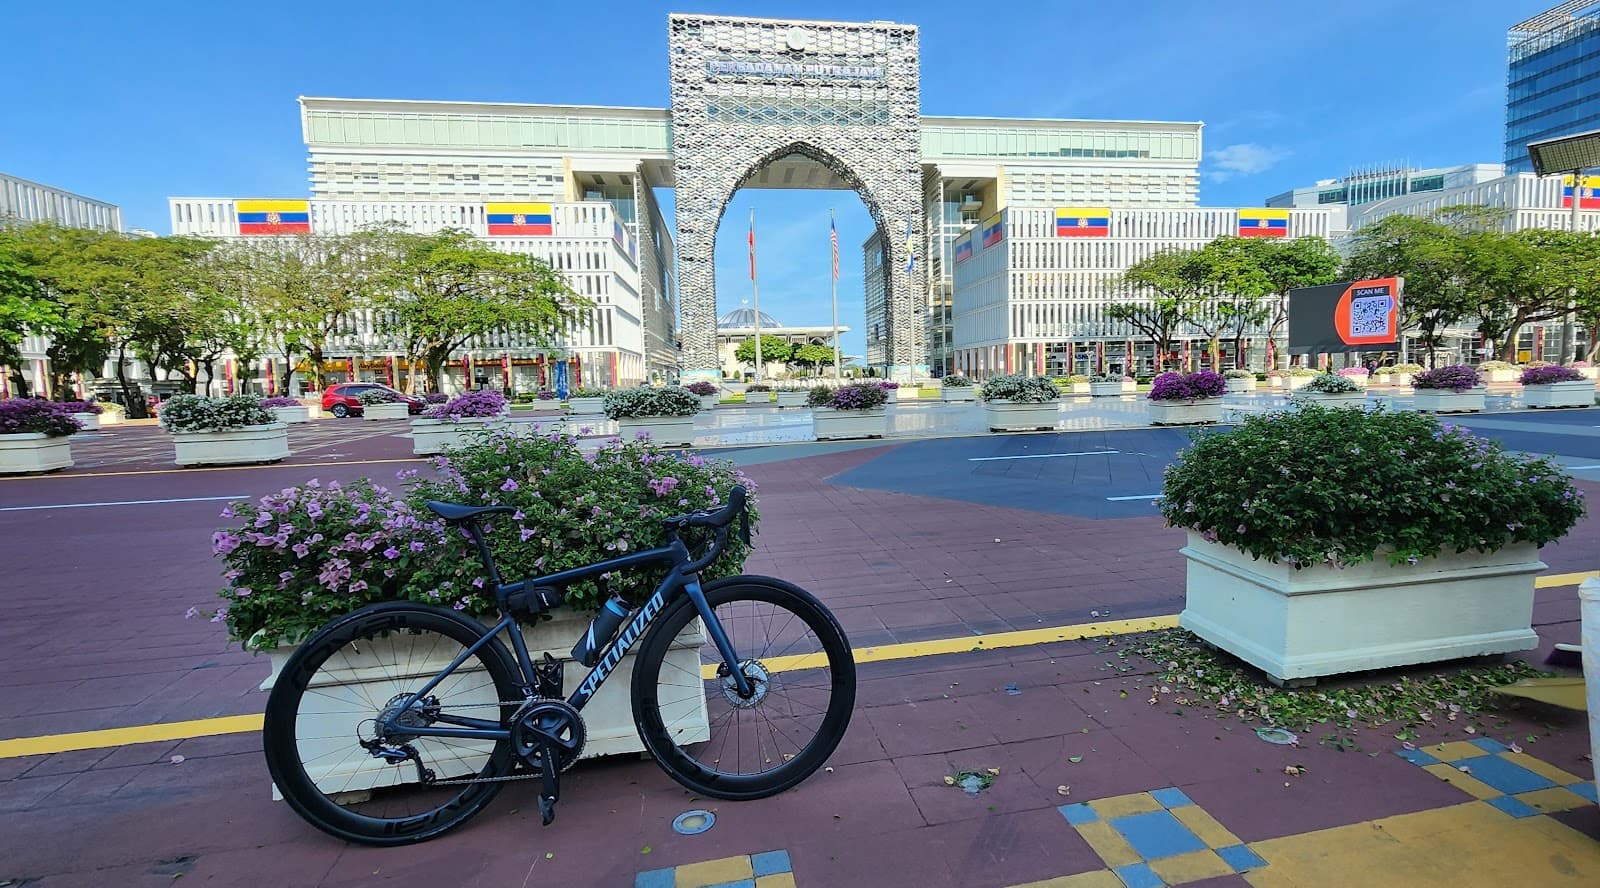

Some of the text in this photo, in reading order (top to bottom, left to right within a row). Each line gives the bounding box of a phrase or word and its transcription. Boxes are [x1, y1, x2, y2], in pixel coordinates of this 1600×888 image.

[709, 61, 885, 77] PERBADANAN PUTRAJAYA
[1356, 288, 1374, 296] SCAN
[579, 591, 665, 703] SPECIALIZED
